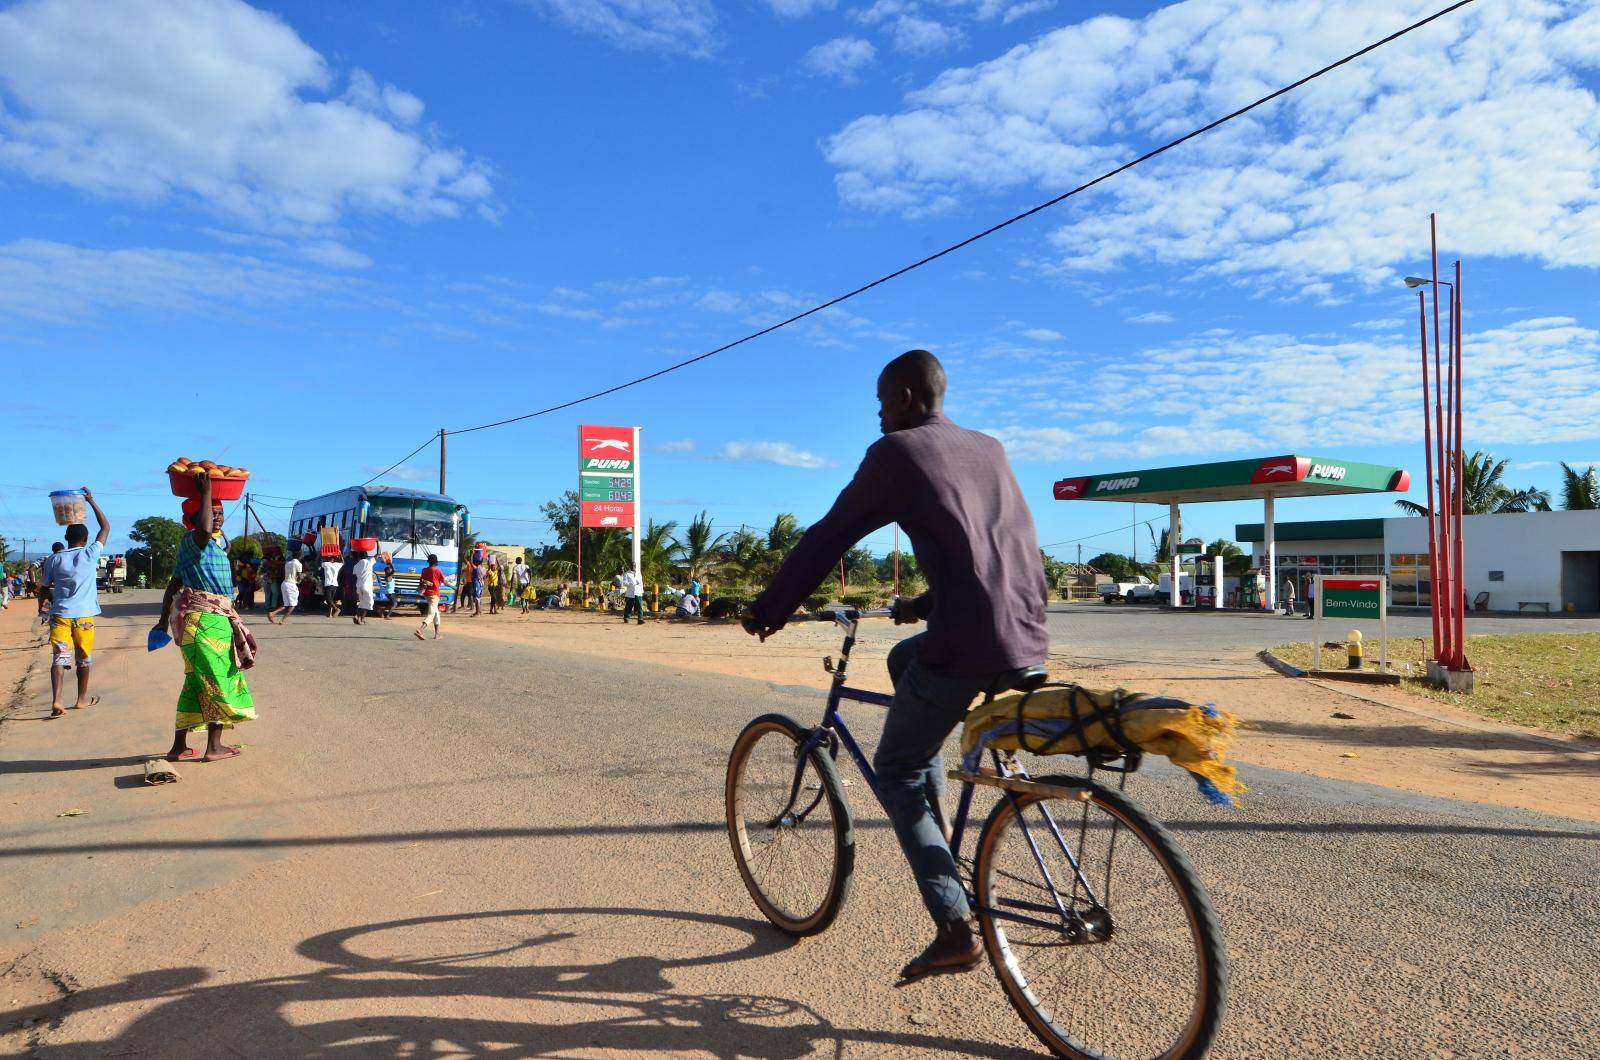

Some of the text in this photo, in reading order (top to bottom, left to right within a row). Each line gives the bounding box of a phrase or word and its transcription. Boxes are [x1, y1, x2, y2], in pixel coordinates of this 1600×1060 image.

[587, 459, 630, 469] PUMA
[1311, 464, 1346, 479] PUMA
[1096, 477, 1140, 491] PUMA
[1326, 599, 1378, 609] Bem-Vindo
